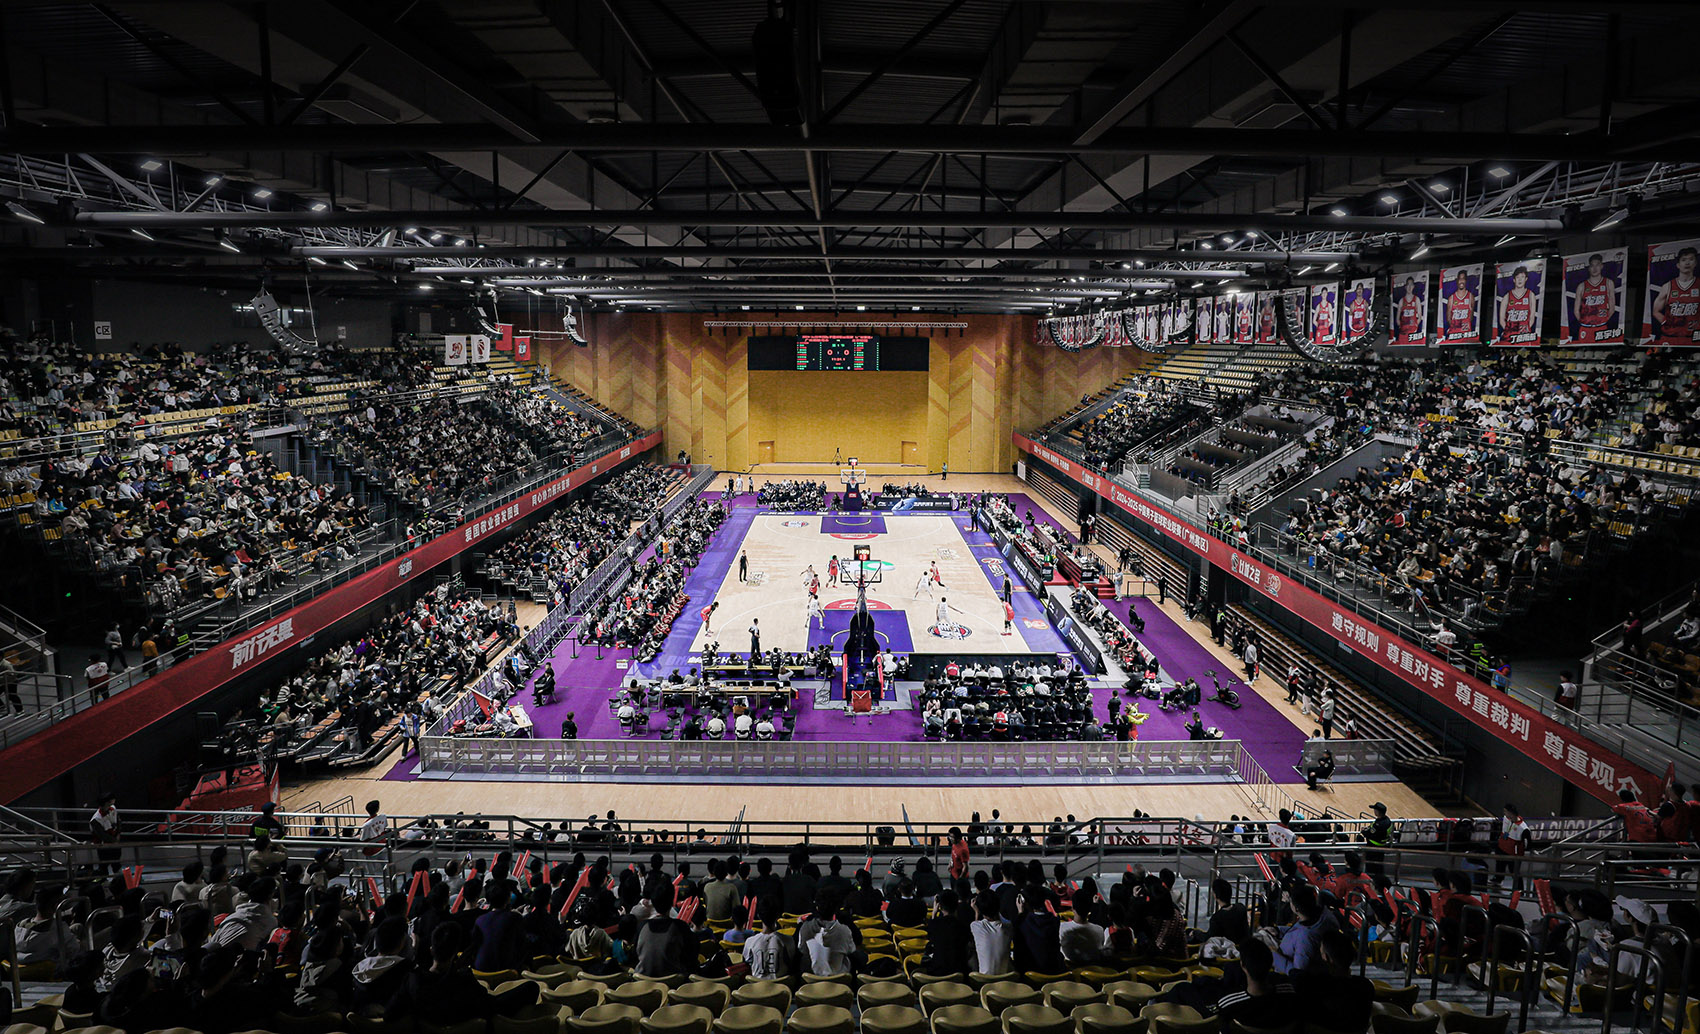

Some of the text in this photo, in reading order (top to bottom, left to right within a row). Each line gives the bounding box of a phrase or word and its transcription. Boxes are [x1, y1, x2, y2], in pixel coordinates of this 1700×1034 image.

[96, 325, 111, 335] C区
[465, 503, 520, 543] 爱国敬业奋发图强
[1331, 611, 1379, 653] 遵守规则
[1386, 642, 1446, 689] 尊重对手
[1454, 680, 1531, 742] 尊重裁判
